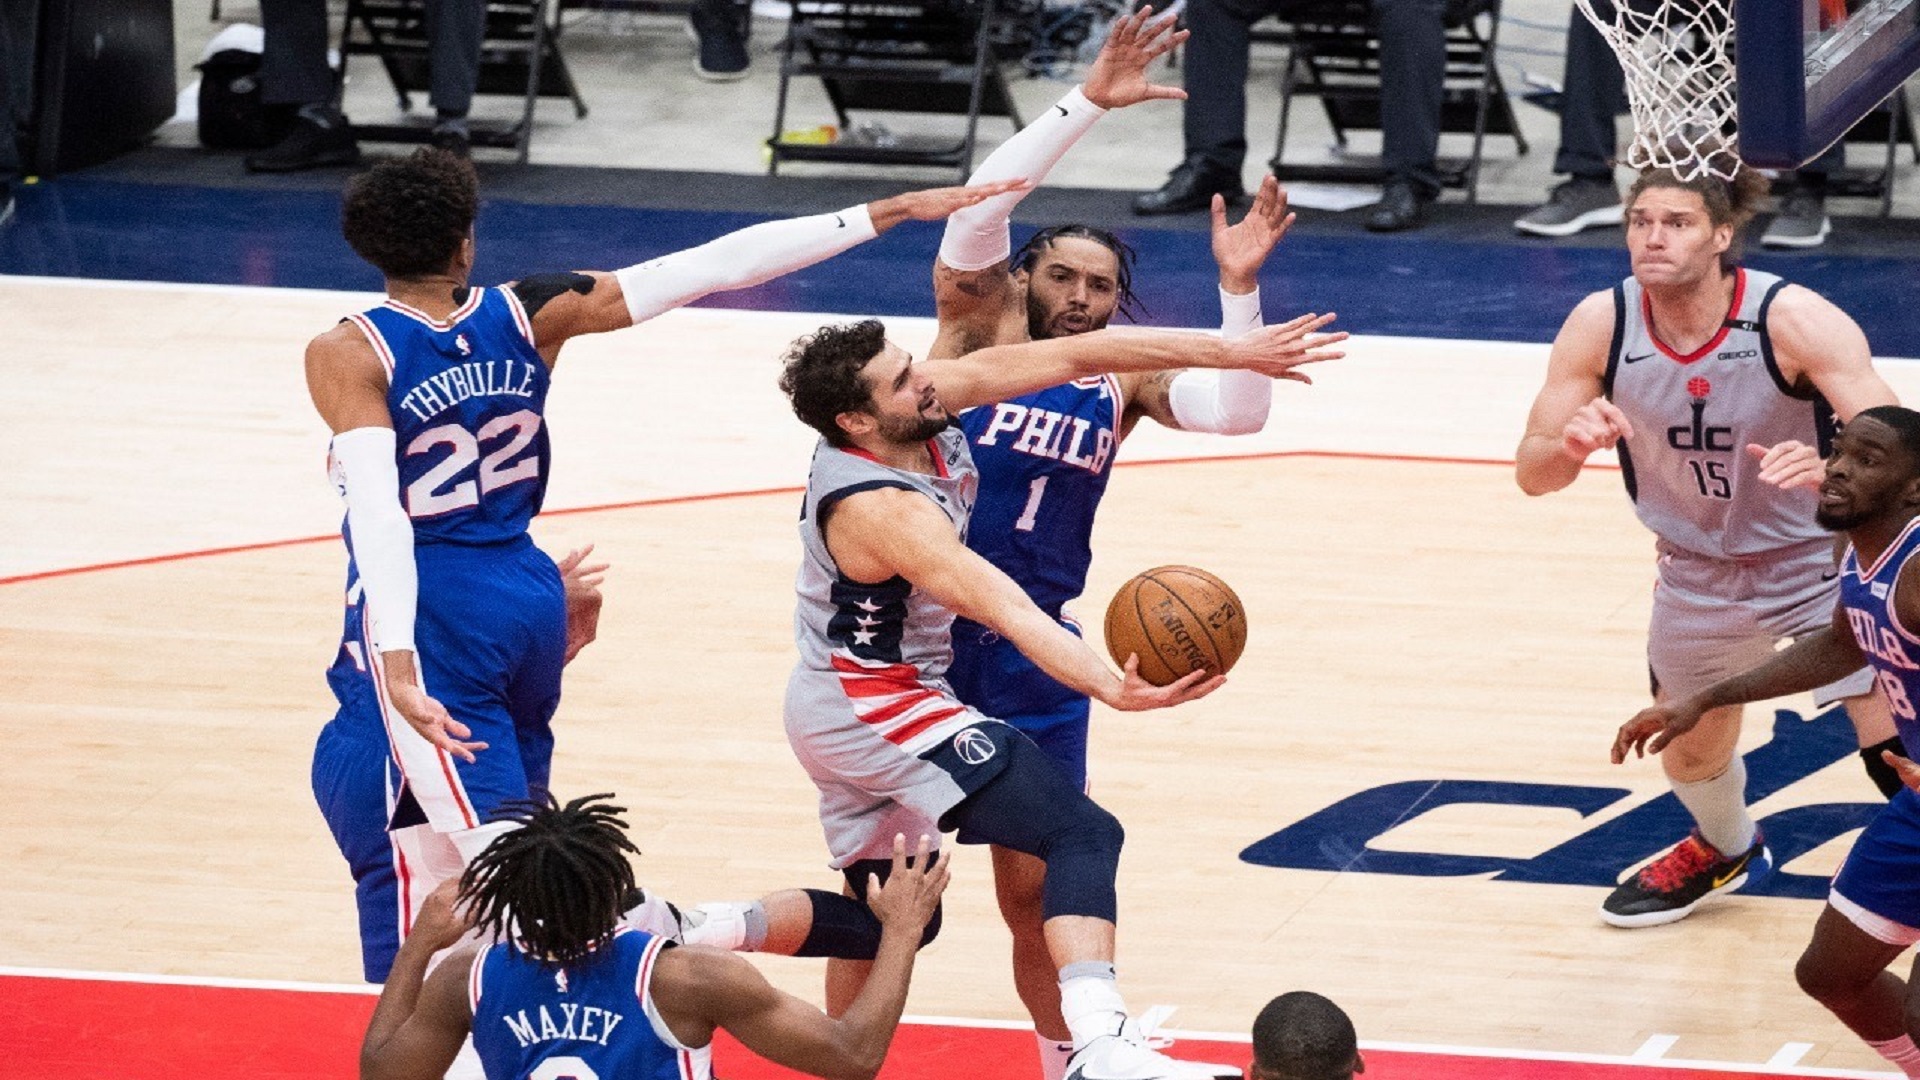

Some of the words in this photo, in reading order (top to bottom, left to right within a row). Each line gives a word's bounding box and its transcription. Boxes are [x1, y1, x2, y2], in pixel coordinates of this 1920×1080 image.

[1717, 350, 1757, 361] GEICO
[400, 360, 536, 422] THYBULLE
[406, 409, 542, 517] 22
[1688, 461, 1732, 499] 15
[1015, 475, 1050, 531] 1
[1846, 607, 1920, 669] HILA
[503, 1003, 623, 1047] MAXEY
